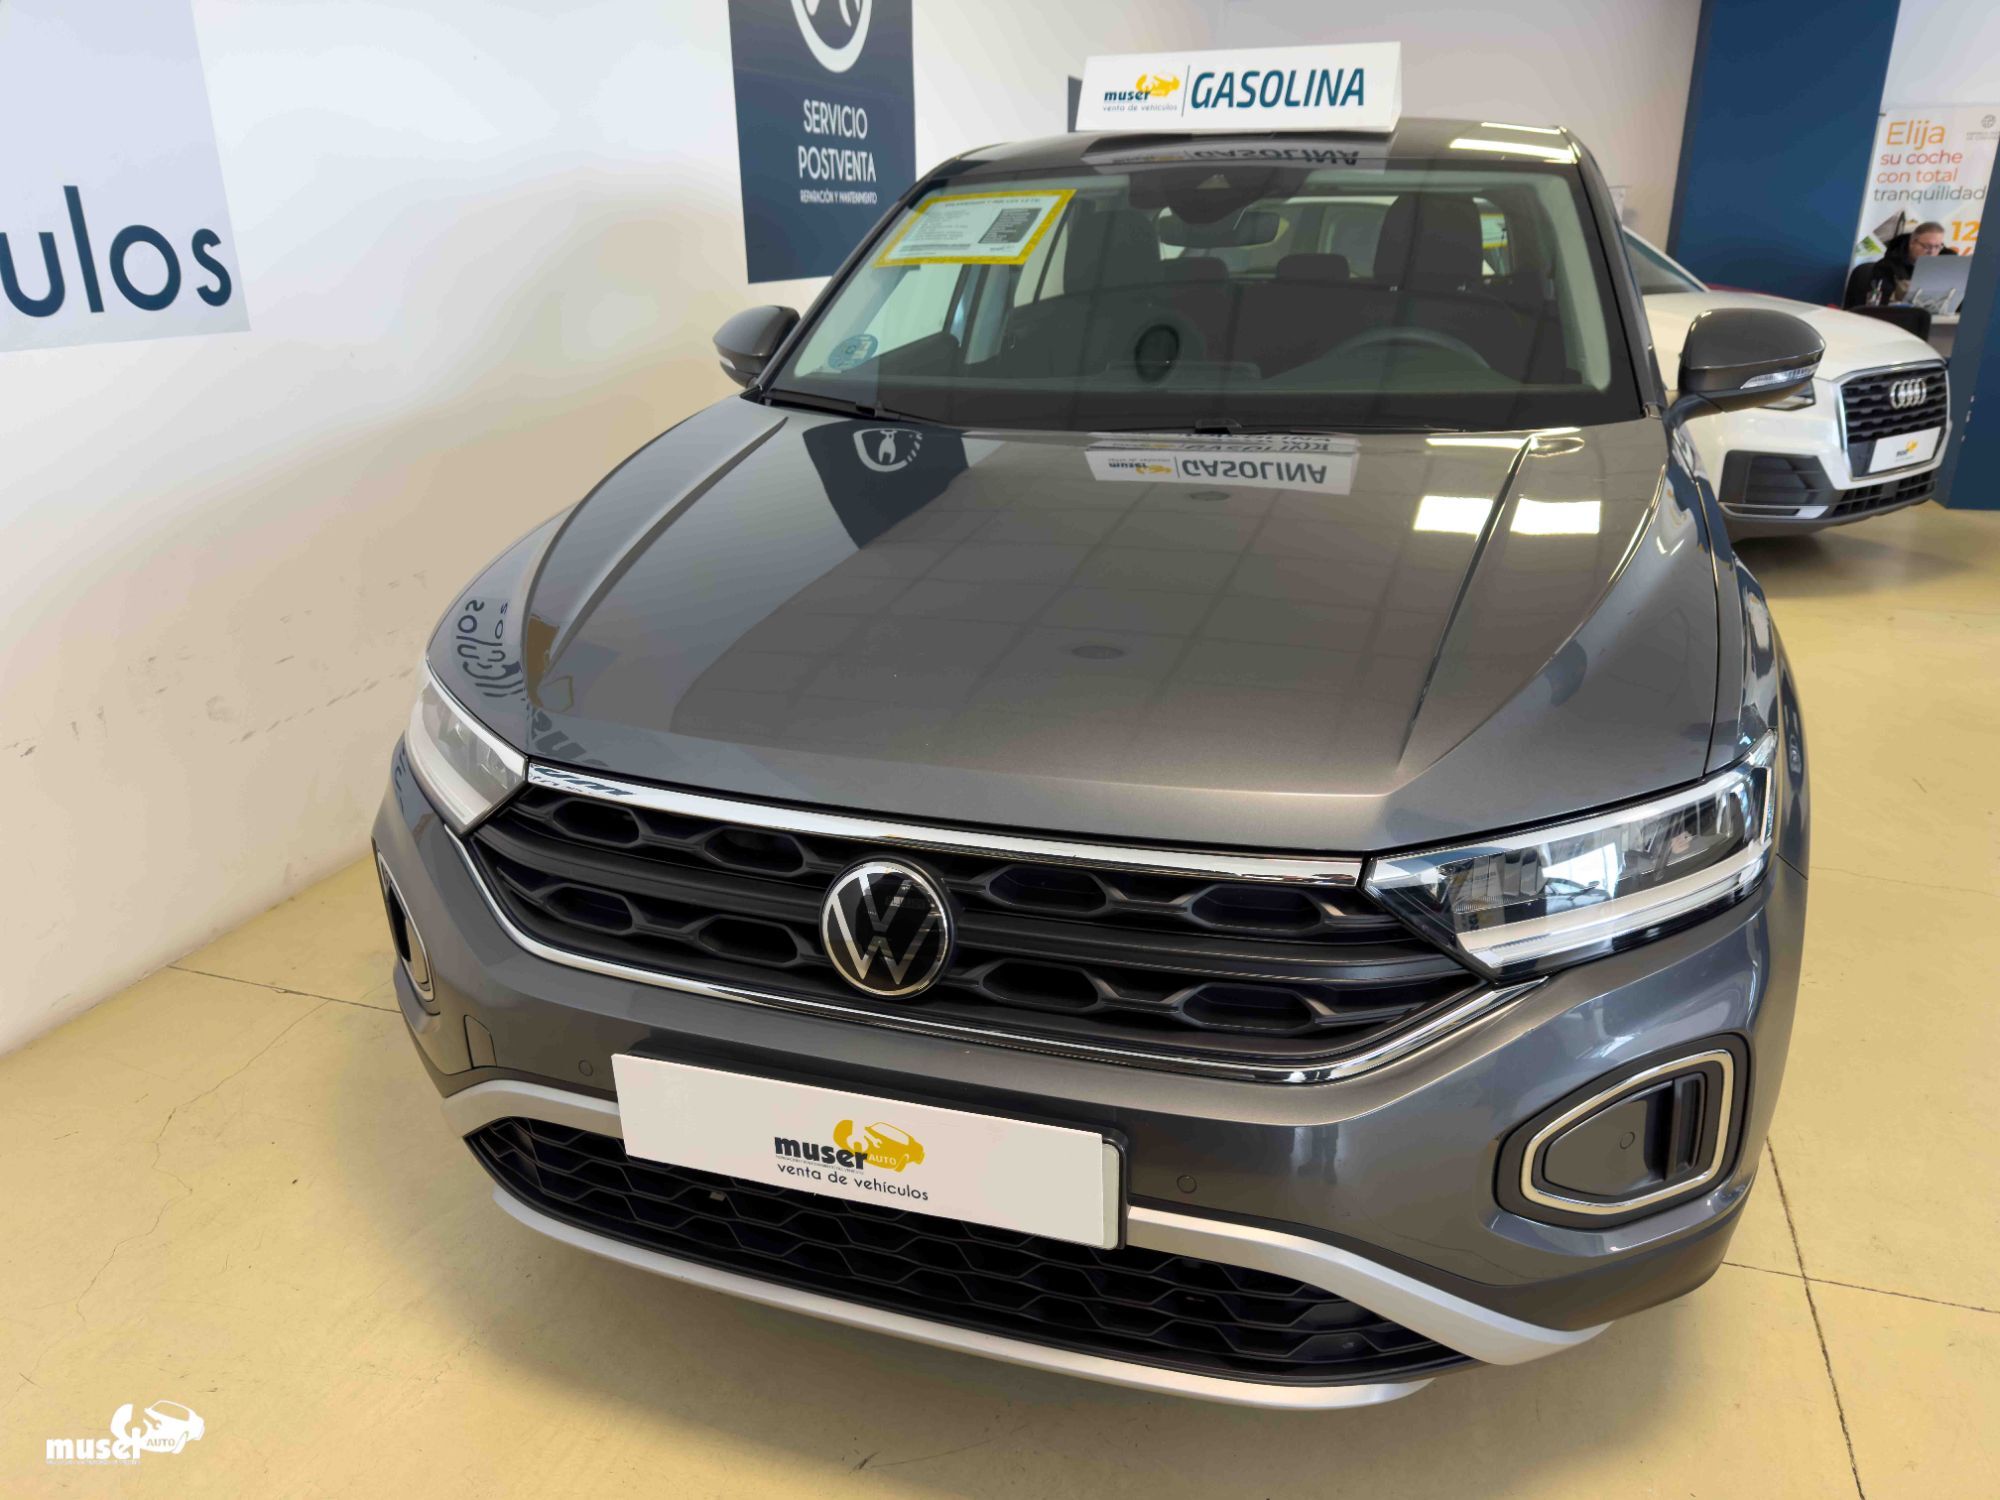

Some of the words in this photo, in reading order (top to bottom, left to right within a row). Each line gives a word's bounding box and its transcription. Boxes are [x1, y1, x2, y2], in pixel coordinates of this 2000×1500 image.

[1104, 88, 1150, 101] muser
[1190, 68, 1365, 109] GASOLINA
[803, 99, 868, 139] SERVICIO
[1127, 103, 1138, 111] de
[1886, 120, 1946, 150] Elija
[798, 145, 876, 183] POSTVENTA
[1880, 153, 1902, 166] su
[1906, 150, 1964, 165] coche
[1876, 170, 1911, 184] con
[1916, 168, 1958, 183] total
[1873, 185, 1988, 204] tranquilidad
[1951, 220, 1981, 241] 12
[0, 185, 232, 317] ulos
[774, 1136, 867, 1170] muser
[868, 1153, 897, 1166] AUTO
[777, 1163, 821, 1180] venta
[827, 1171, 848, 1185] de
[854, 1178, 929, 1201] vehículos
